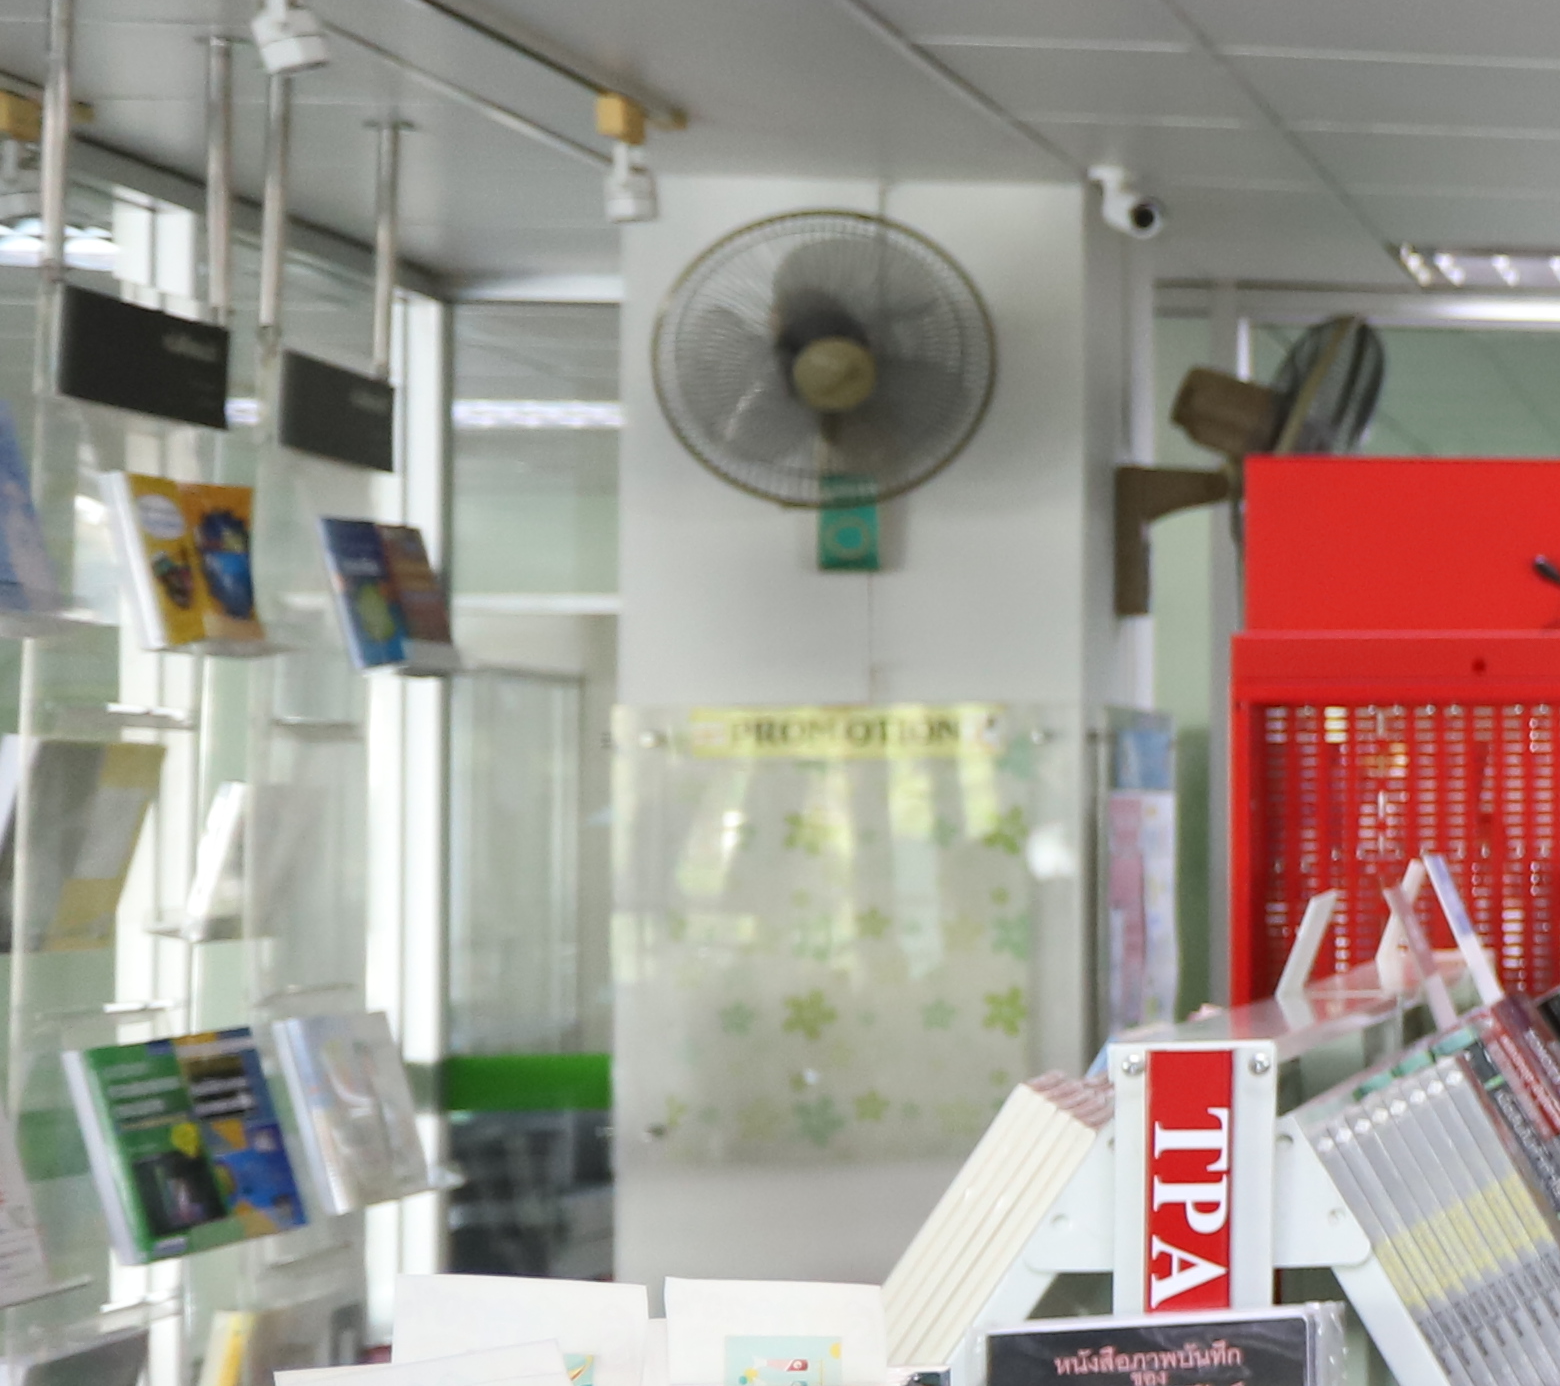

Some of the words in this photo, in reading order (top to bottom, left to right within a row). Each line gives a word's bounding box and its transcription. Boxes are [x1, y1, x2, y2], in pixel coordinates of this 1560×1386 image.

[724, 714, 962, 749] PROMOTION
[1150, 1106, 1229, 1310] TPA
[1054, 1339, 1243, 1376] หนังสือภาพบันทึก
[1130, 1369, 1168, 1386] ของ
